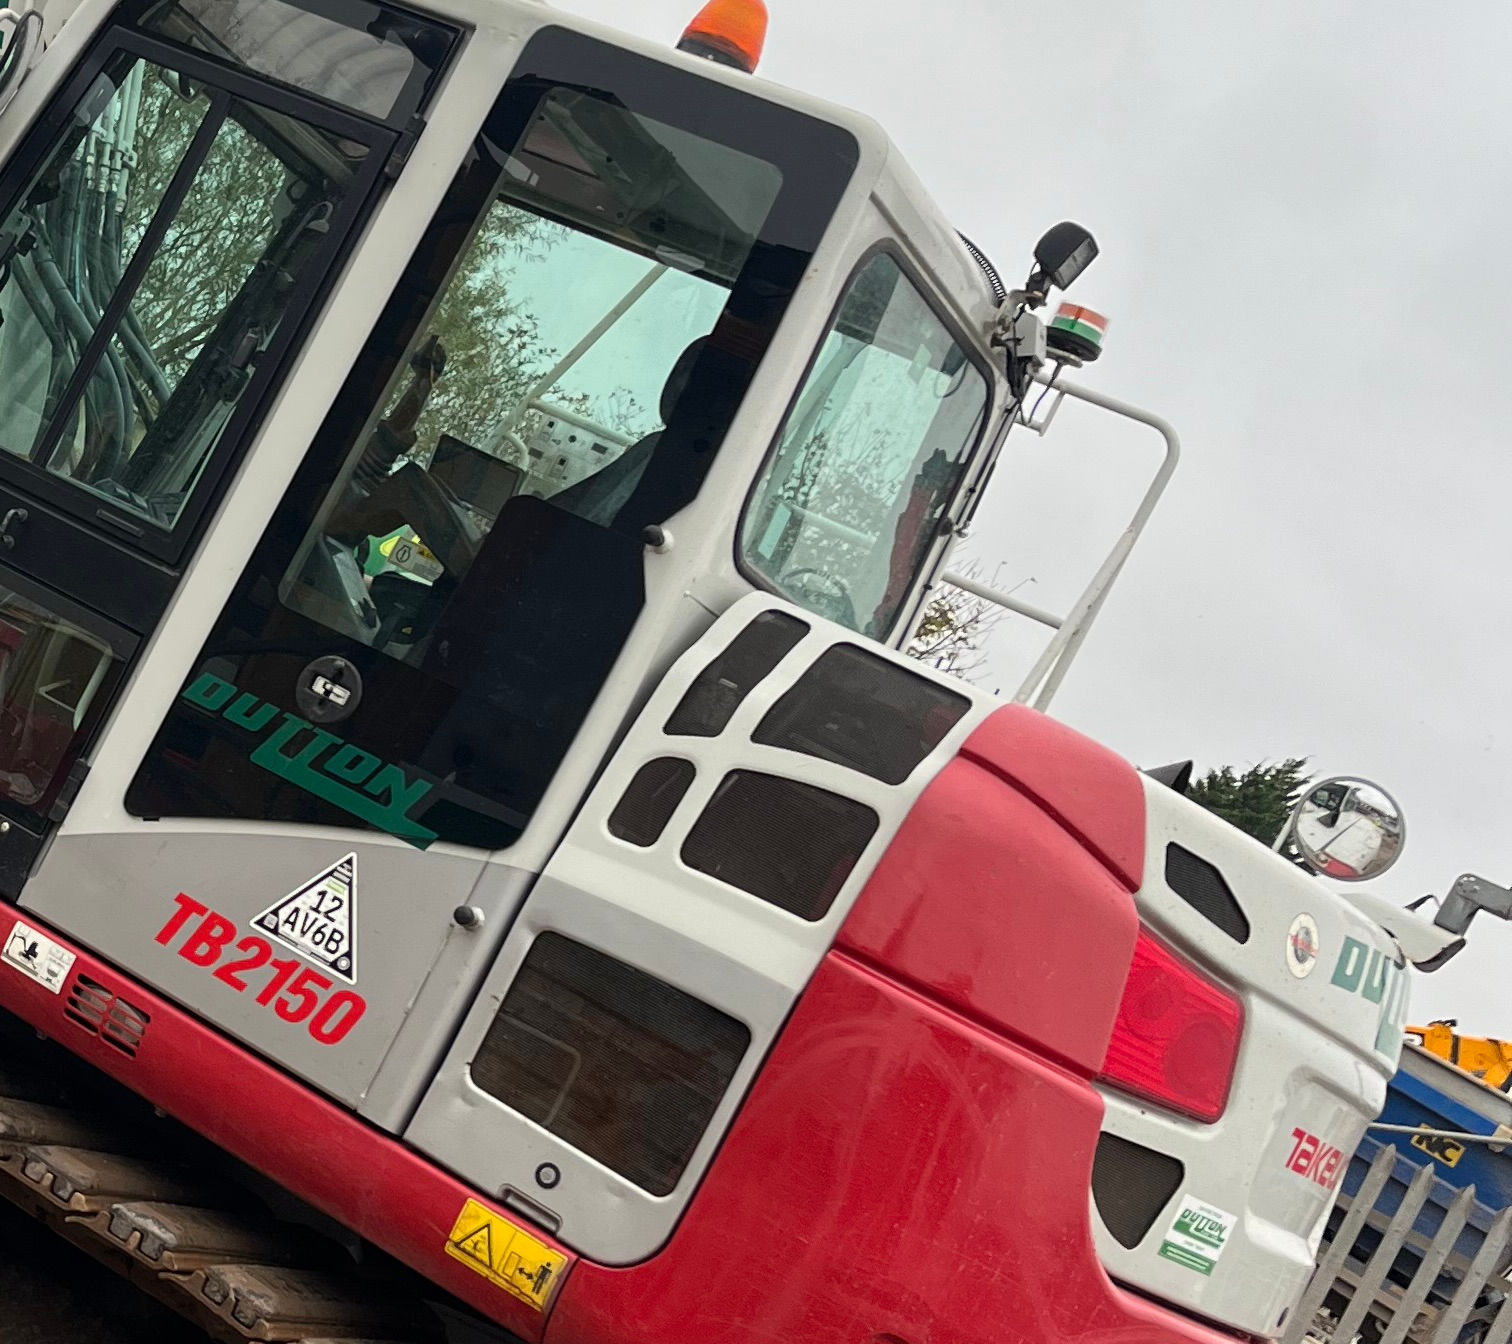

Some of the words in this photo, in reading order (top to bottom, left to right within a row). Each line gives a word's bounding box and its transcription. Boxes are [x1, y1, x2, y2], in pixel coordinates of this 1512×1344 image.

[181, 671, 439, 852] DUTTON
[282, 906, 344, 955] AV6B
[309, 890, 344, 922] 12
[154, 892, 367, 1045] TB2150
